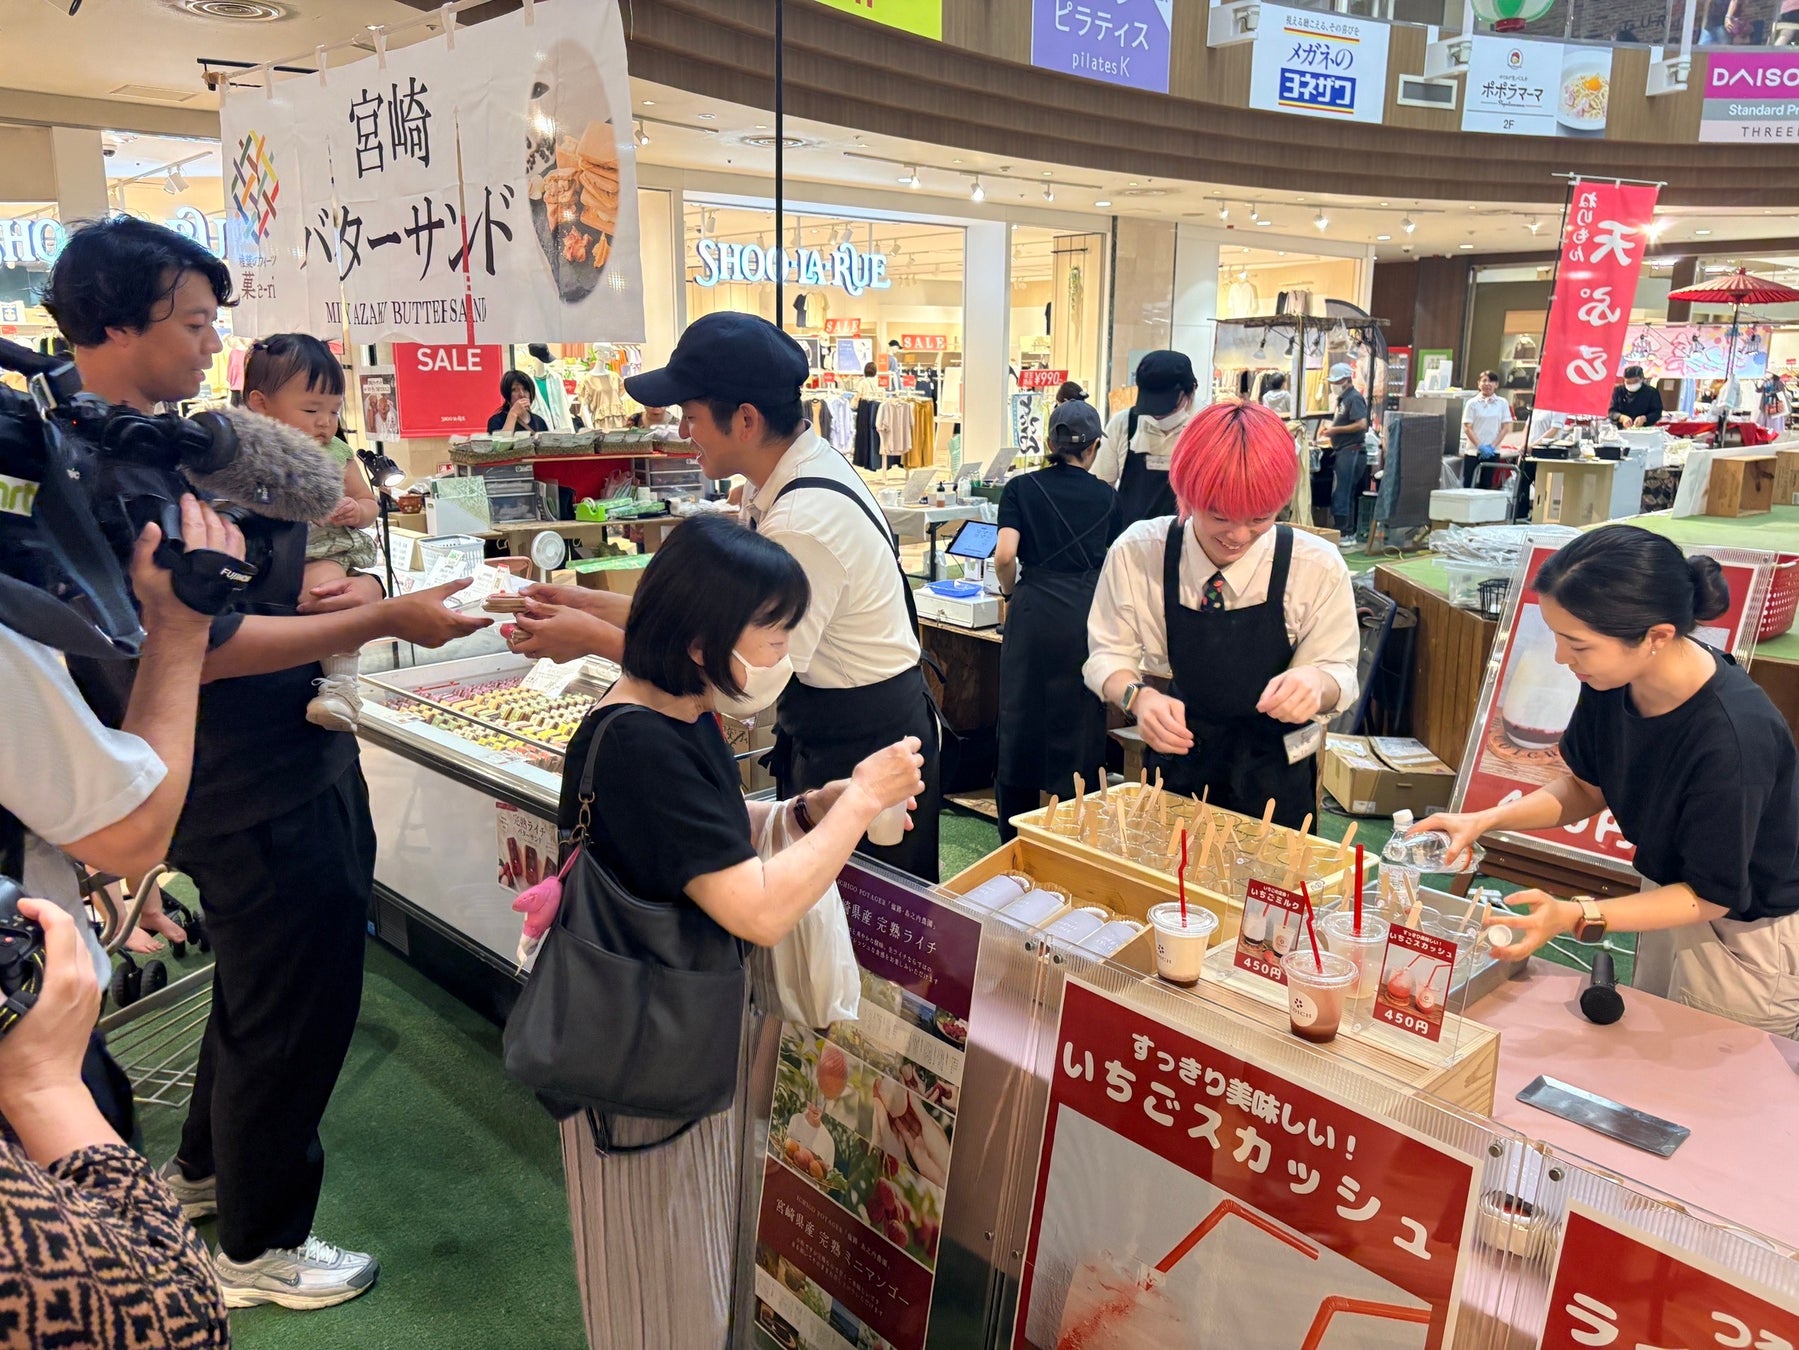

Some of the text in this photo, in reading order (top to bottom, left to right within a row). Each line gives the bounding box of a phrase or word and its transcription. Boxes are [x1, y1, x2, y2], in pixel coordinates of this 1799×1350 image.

[1055, 1, 1150, 51] ピラティス
[1072, 51, 1131, 78] pilates K
[1286, 42, 1354, 71] メガネの
[1283, 72, 1353, 105] ヨネザワ
[1712, 67, 1799, 87] DAISO
[1481, 81, 1544, 102] ポポラマーマ
[1729, 104, 1784, 116] Standard
[349, 76, 432, 179] 宮崎
[1503, 119, 1516, 130] 2F
[1741, 126, 1799, 138] THREE
[300, 183, 515, 282] バターサンド
[825, 320, 859, 333] SALE
[903, 335, 946, 349] SALE
[417, 347, 482, 371] SALE
[1250, 887, 1301, 911] いちごミルク
[876, 916, 937, 955] 完熟ライチ
[1243, 957, 1283, 981] 450円
[1384, 1009, 1430, 1036] 450円
[1131, 1033, 1357, 1161] すっきり美味しい！
[1062, 1041, 1433, 1261] いちごスカッシュ
